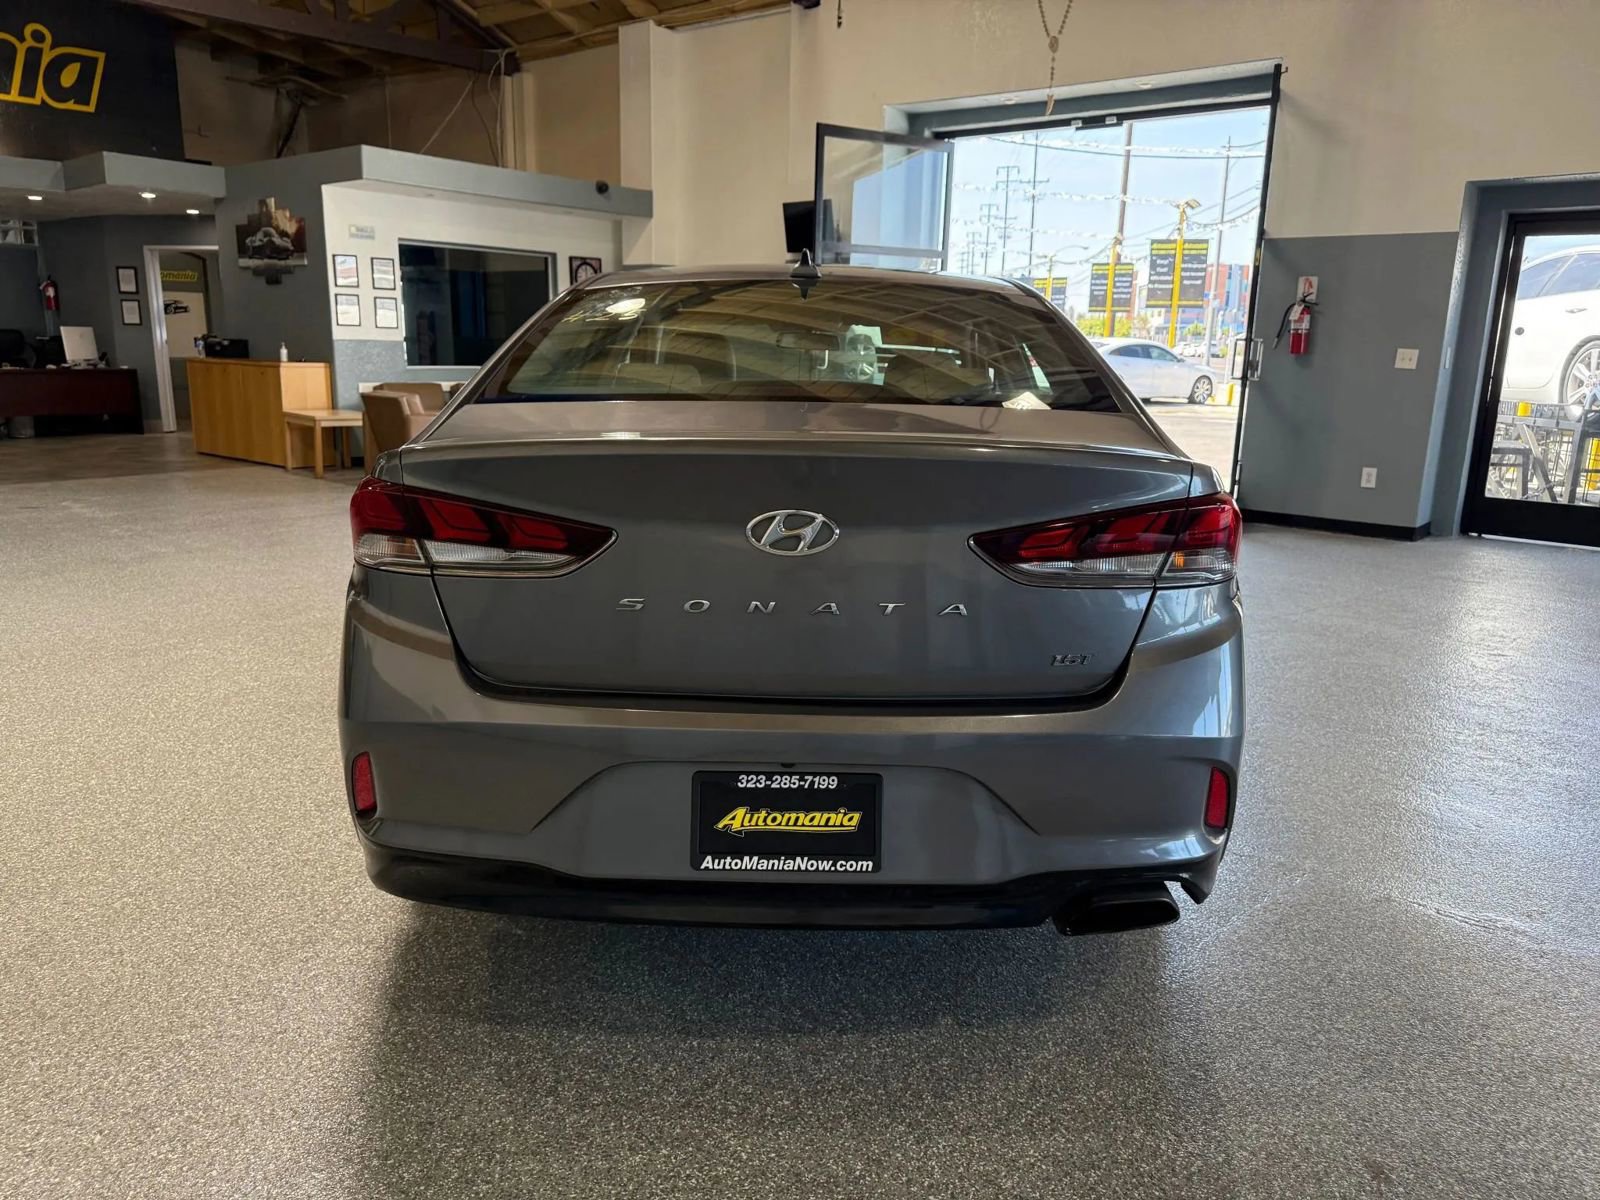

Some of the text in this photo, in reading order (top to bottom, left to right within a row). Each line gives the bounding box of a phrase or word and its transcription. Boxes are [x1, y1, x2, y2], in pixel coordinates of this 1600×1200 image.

[615, 598, 969, 618] SONATA
[737, 774, 838, 789] 323-285-7199
[714, 806, 862, 837] Automania
[700, 855, 873, 872] AutoManiaNow.com
